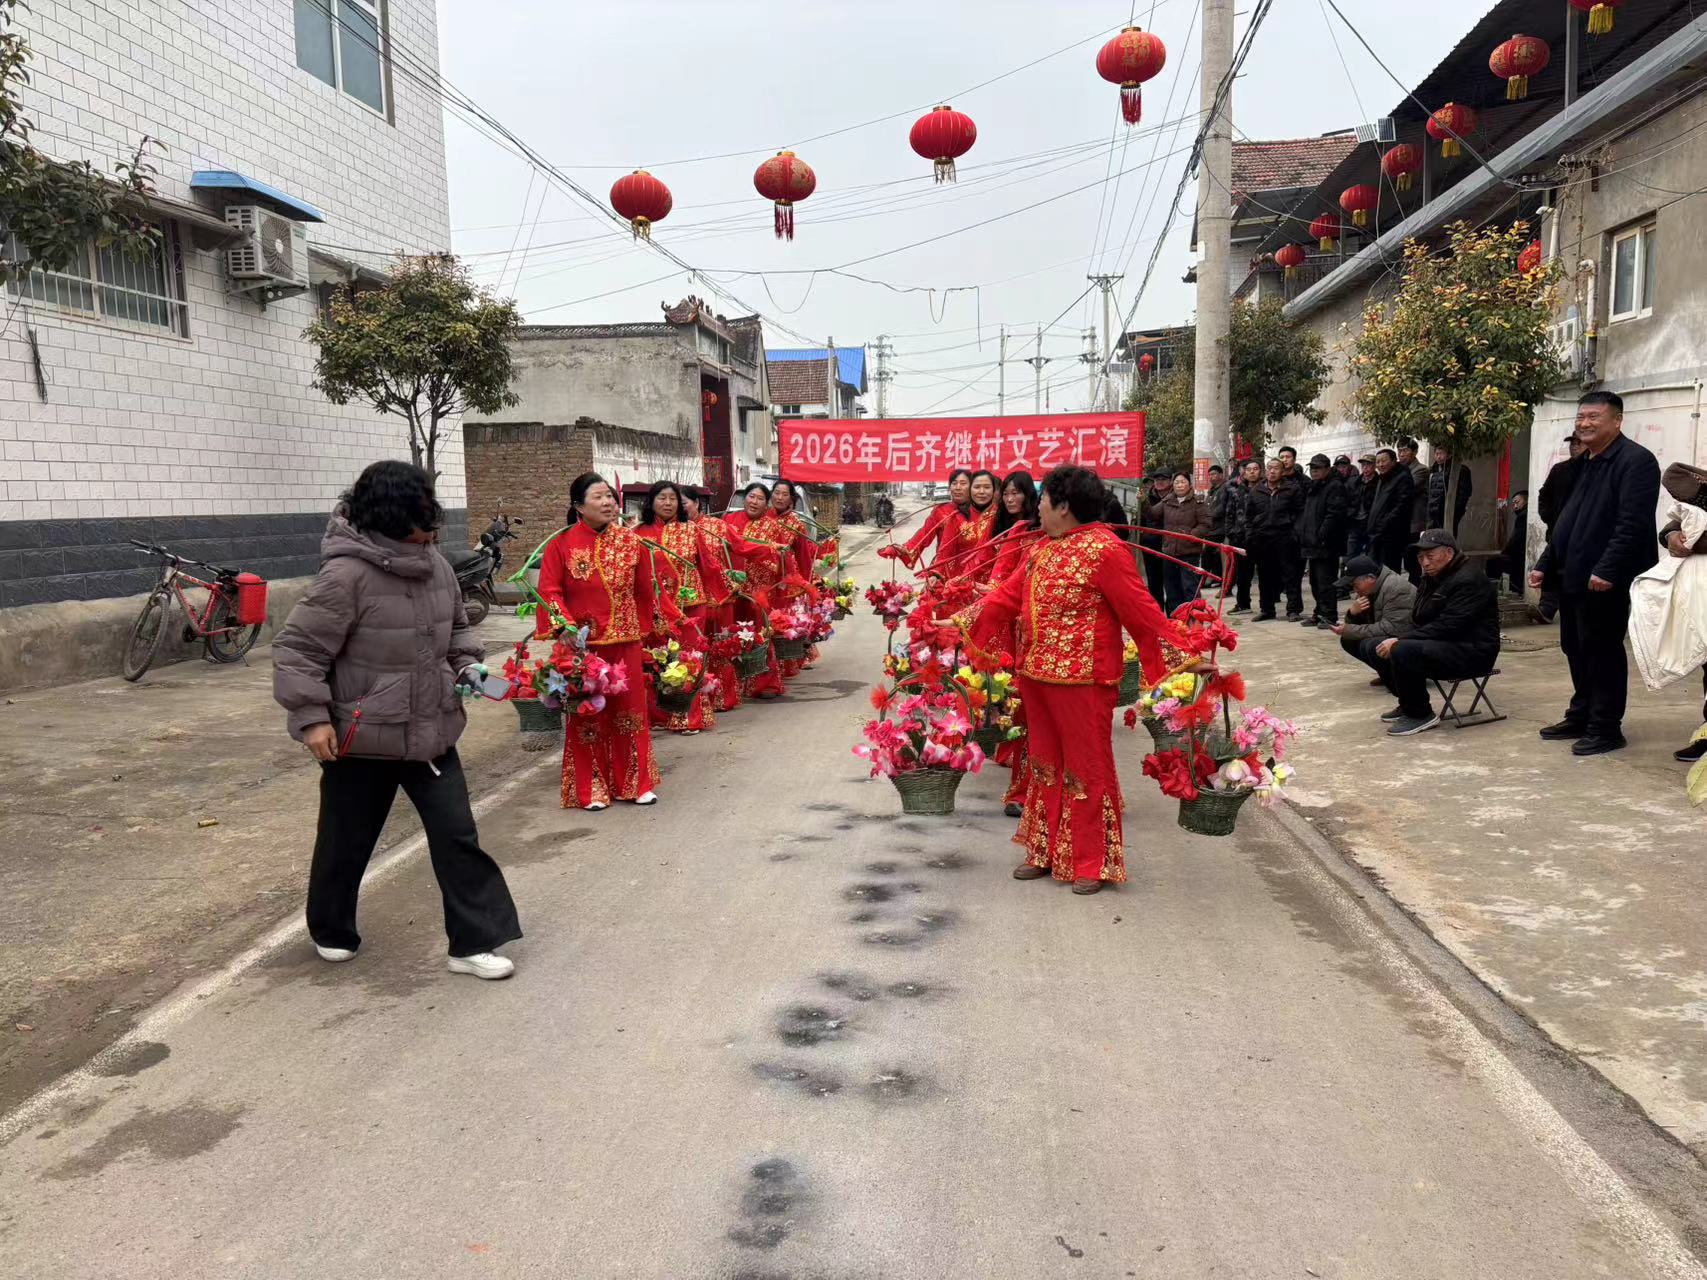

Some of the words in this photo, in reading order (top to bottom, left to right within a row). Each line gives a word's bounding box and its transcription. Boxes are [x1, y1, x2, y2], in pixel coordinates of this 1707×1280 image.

[790, 424, 1129, 472] 2026年后齐继村文艺汇演
